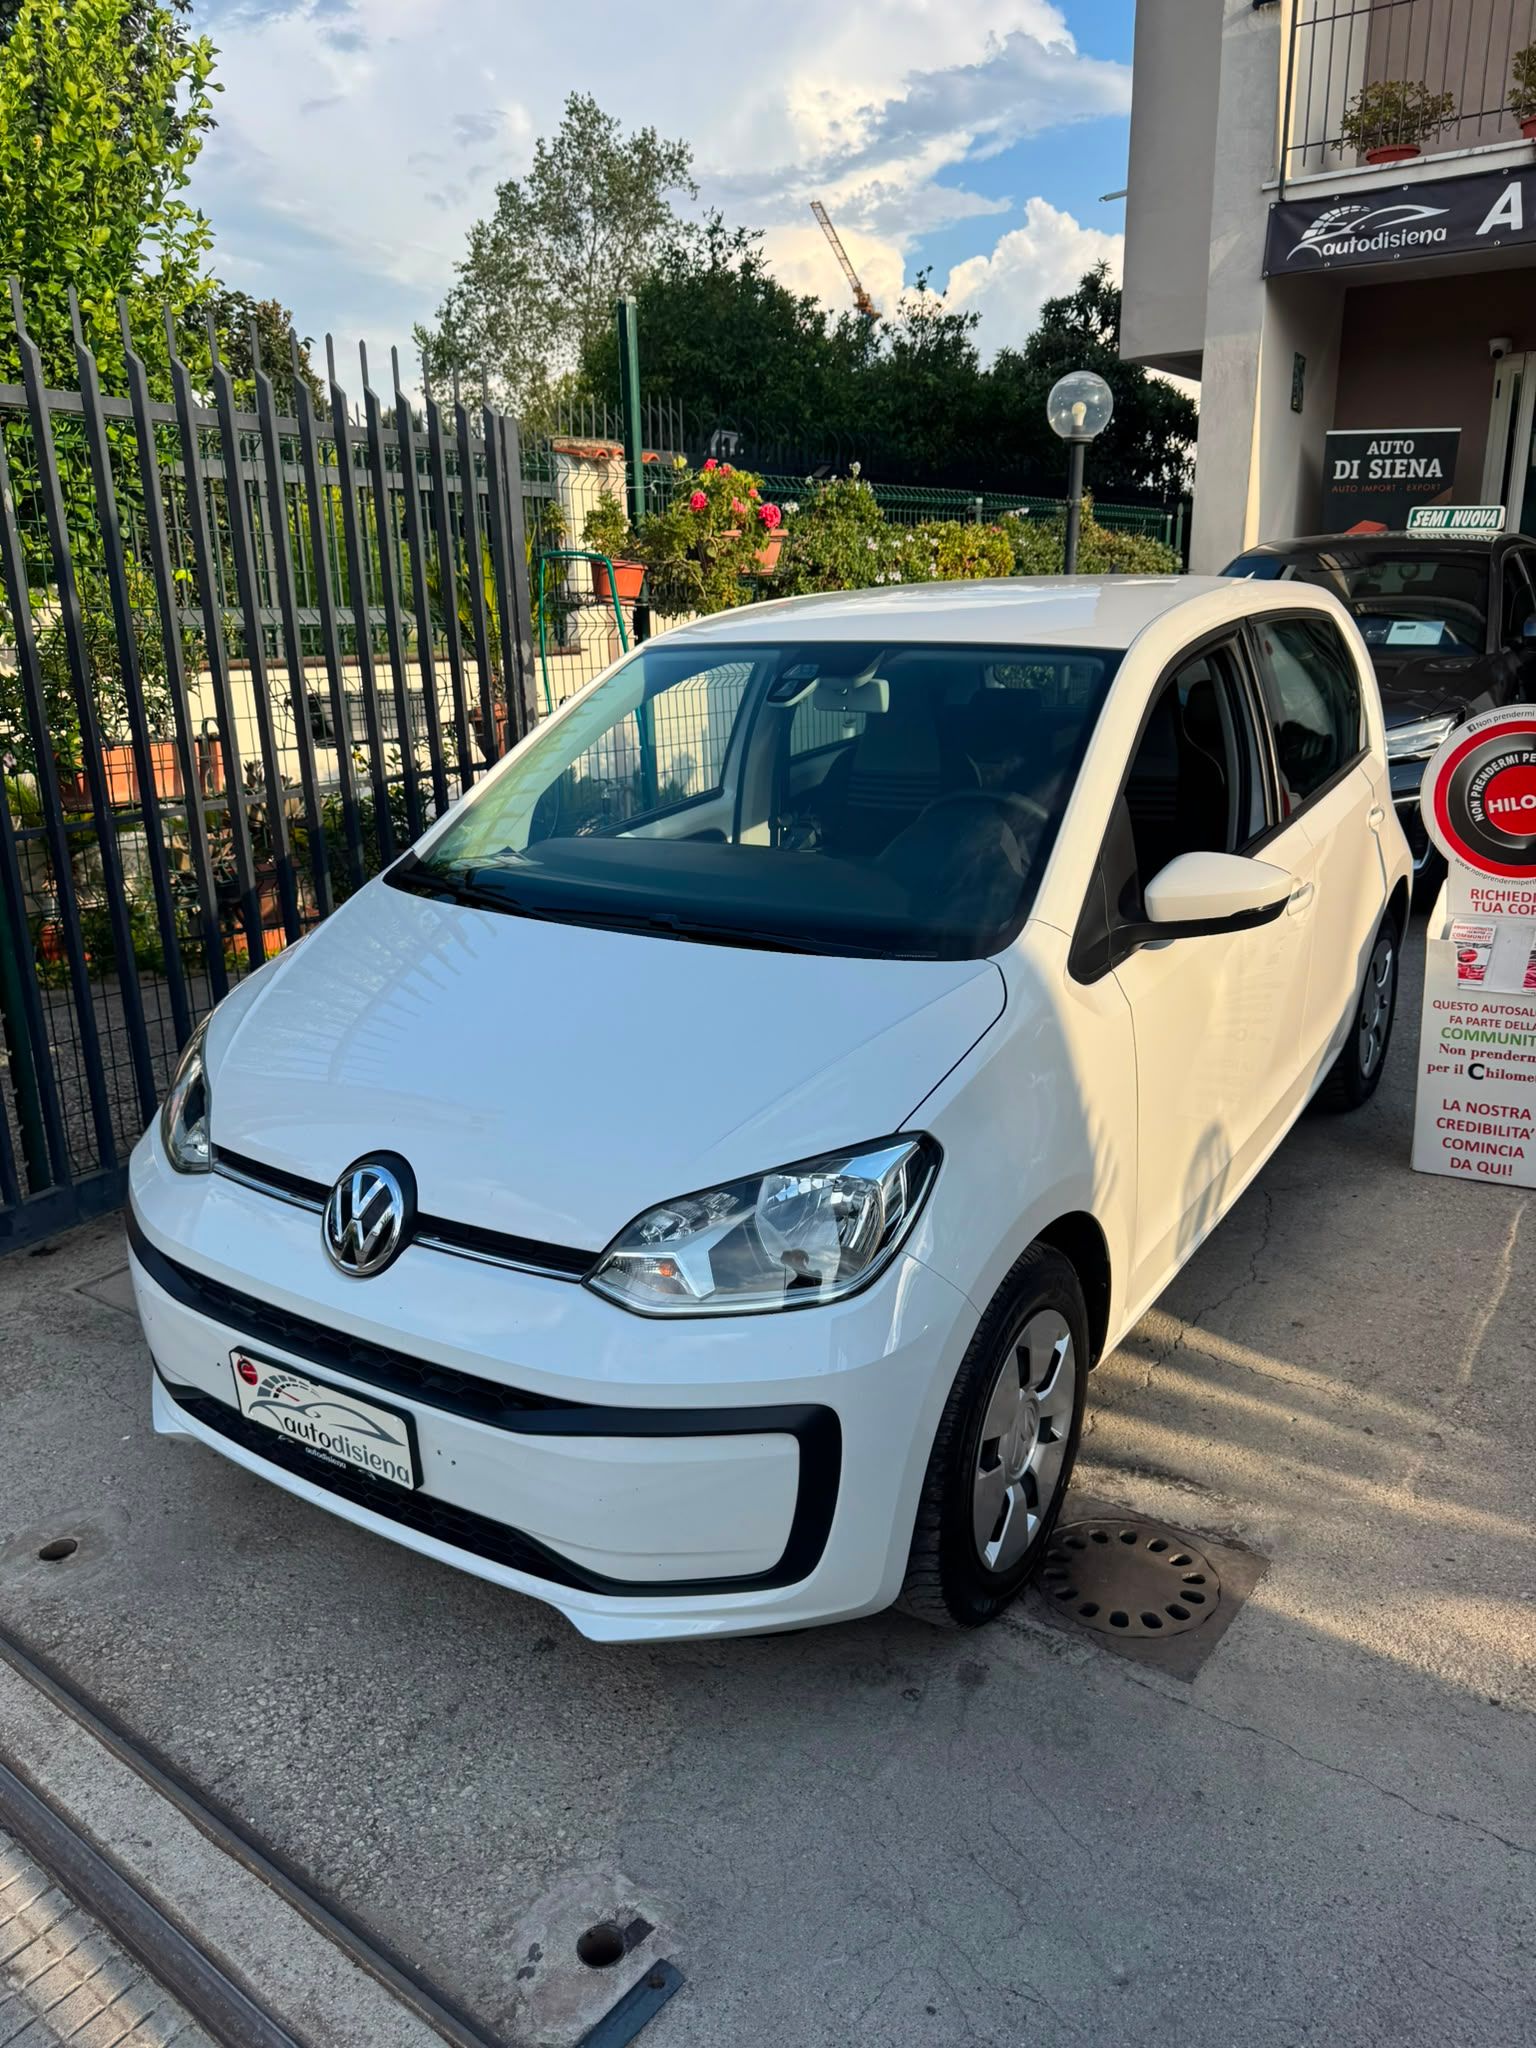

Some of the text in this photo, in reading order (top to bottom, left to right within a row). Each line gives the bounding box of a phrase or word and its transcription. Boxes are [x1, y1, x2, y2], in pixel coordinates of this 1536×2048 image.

[1322, 227, 1447, 256] autodisiena
[1366, 440, 1415, 455] AUTO
[1333, 458, 1443, 480] DI SIENA
[1331, 483, 1441, 493] AUTO IMPORT EXPORT
[1412, 510, 1498, 527] SEMI NUOVA
[1475, 711, 1535, 729] Non prendermi
[1471, 754, 1519, 798] PRENDERMI
[1470, 800, 1485, 822] NON
[1472, 901, 1503, 913] TUA
[1433, 1000, 1536, 1017] QUESTO AUTOSAL
[1449, 1015, 1536, 1031] FA PARTE DELLA
[1441, 1027, 1536, 1047] COMMUNIT
[1439, 1043, 1466, 1056] Non
[1427, 1063, 1536, 1083] per il Chilome
[1443, 1099, 1531, 1120] LA NOSTRA
[1442, 1137, 1525, 1159] COMINCIA
[1450, 1157, 1513, 1176] DA QUI!
[284, 1416, 410, 1484] autodisiena
